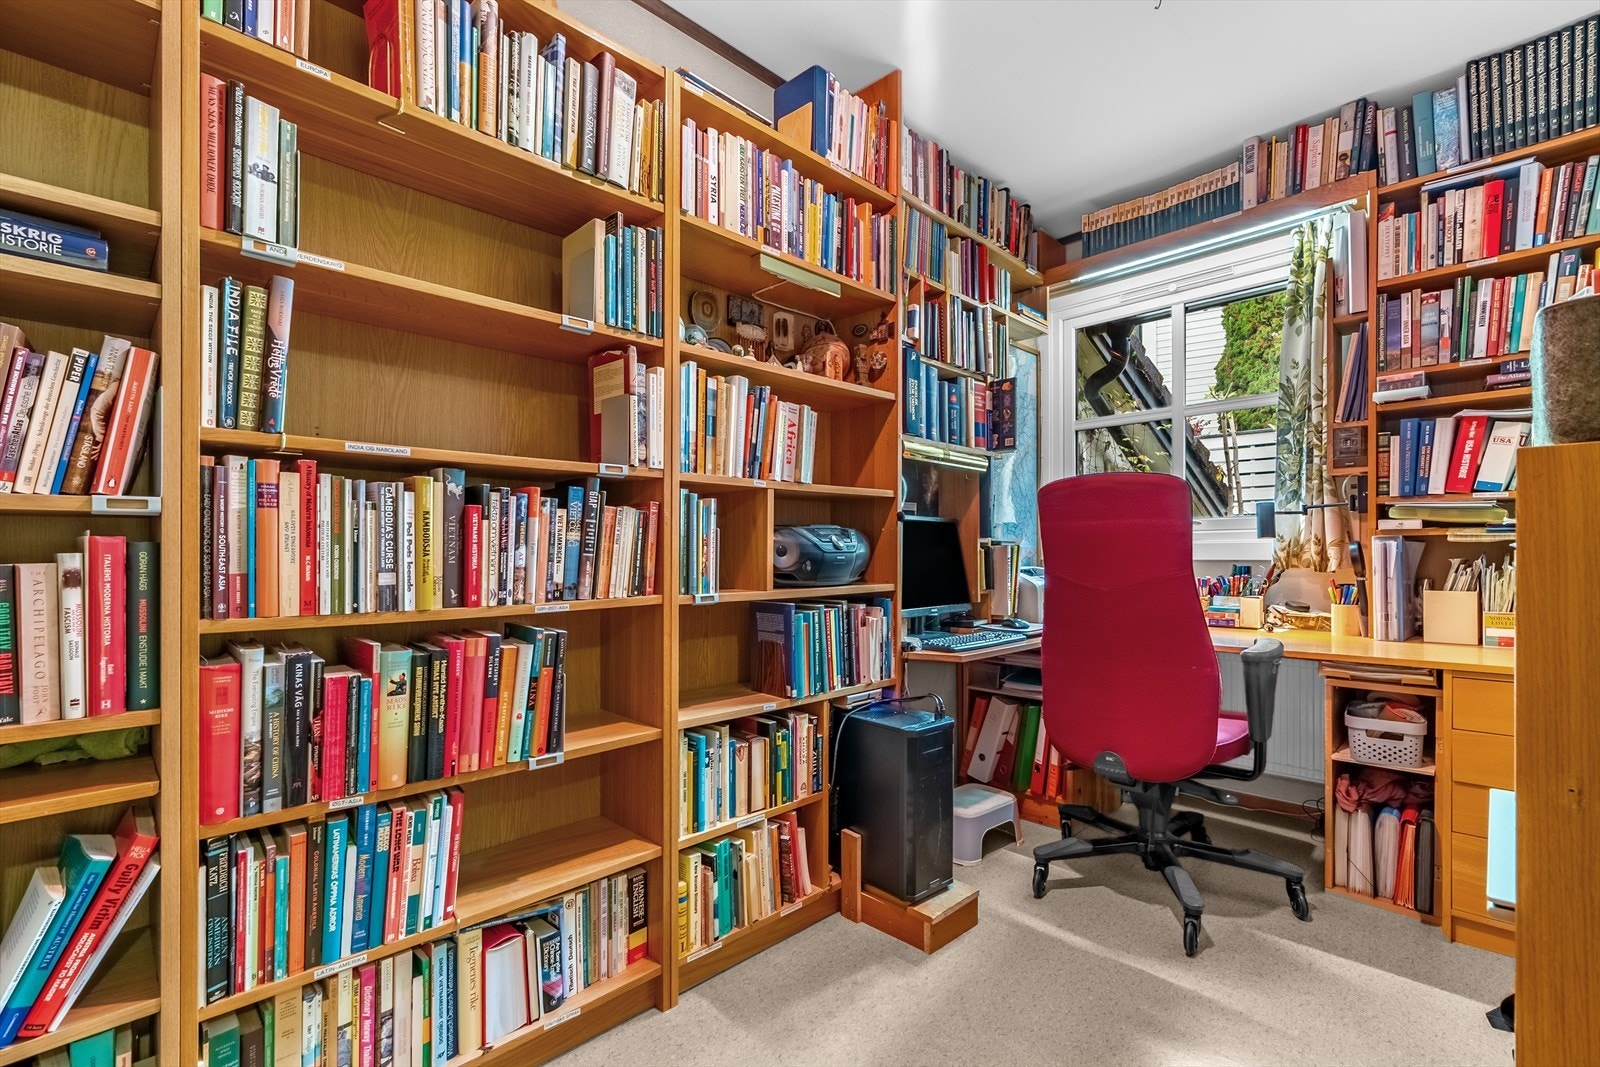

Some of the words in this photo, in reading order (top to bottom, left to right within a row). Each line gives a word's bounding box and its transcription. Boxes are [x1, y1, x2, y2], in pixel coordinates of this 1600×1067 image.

[300, 61, 328, 78] EUROPA
[206, 85, 217, 106] MENS
[206, 108, 217, 129] SEKS
[1365, 104, 1374, 134] CONQUEST
[206, 131, 217, 172] MILLIONER
[1245, 144, 1256, 174] COLONIALISM
[1310, 140, 1321, 168] Sapiens
[1574, 166, 1583, 192] HUNGARY
[771, 185, 781, 220] PALESTINA
[0, 223, 63, 245] SKRIG
[0, 234, 62, 257] ISTORIE
[230, 285, 241, 320] INDIA
[226, 323, 238, 356] FILE
[69, 357, 83, 382] PIPER
[227, 361, 235, 382] TREVOR
[5, 419, 24, 460] TaschenAtlas
[15, 390, 31, 418] Deutsche
[76, 435, 94, 468] STASILAND
[376, 446, 408, 454] NABOLAND
[786, 418, 798, 464] Africa
[1458, 454, 1471, 478] HISTORIE
[385, 486, 394, 538] CAMBODIA'S
[490, 499, 498, 521] fakta
[588, 491, 598, 508] GIAP
[305, 521, 313, 548] Indonesia
[422, 510, 431, 558] KAMBODSJA
[448, 515, 456, 565] VIETNAM
[218, 535, 226, 574] SOUTH-EAST
[385, 542, 394, 570] CURSE
[490, 540, 498, 576] vietnam
[104, 554, 112, 582] ITALIENS
[104, 583, 112, 614] MODERNA
[0, 602, 10, 626] GOOD
[139, 598, 148, 633] MUSSOLINI
[32, 580, 46, 680] ARCHIPELAGO
[104, 616, 112, 646] HISTORIA
[0, 652, 11, 675] BAD
[294, 664, 303, 688] KINAS
[432, 660, 440, 680] KINAS
[139, 672, 148, 689] MAKT
[40, 684, 48, 704] JOHN
[432, 695, 440, 718] ANSIKT
[528, 682, 538, 708] KINA
[314, 721, 322, 737] HAN
[396, 811, 404, 829] THE
[131, 845, 150, 854] HELLA
[394, 830, 402, 851] LONG
[312, 850, 320, 882] COLONIAL
[331, 829, 341, 880] LATINAMERIKAS
[358, 854, 370, 878] Modern
[392, 853, 401, 873] WAR
[113, 863, 138, 893] Guilty
[209, 866, 218, 886] KATZ
[219, 852, 229, 893] FRIEDRICH
[410, 858, 422, 882] Bolivia
[88, 896, 116, 930] Victim
[355, 894, 366, 920] America
[636, 882, 645, 920] JAPANESE-
[40, 934, 62, 968] AUSTRIA
[66, 932, 89, 968] HOLOCAUST
[80, 933, 96, 957] AUSTRIA
[214, 917, 222, 966] AMERICAN
[68, 958, 81, 974] FROM
[316, 956, 366, 979] LATIN-AMERIKA
[466, 944, 480, 991] Tegnenes
[44, 977, 60, 1003] HAIDER
[60, 976, 72, 989] THE
[362, 986, 373, 1017] Dictionary
[469, 993, 479, 1012] rike
[362, 1020, 373, 1042] Norway
